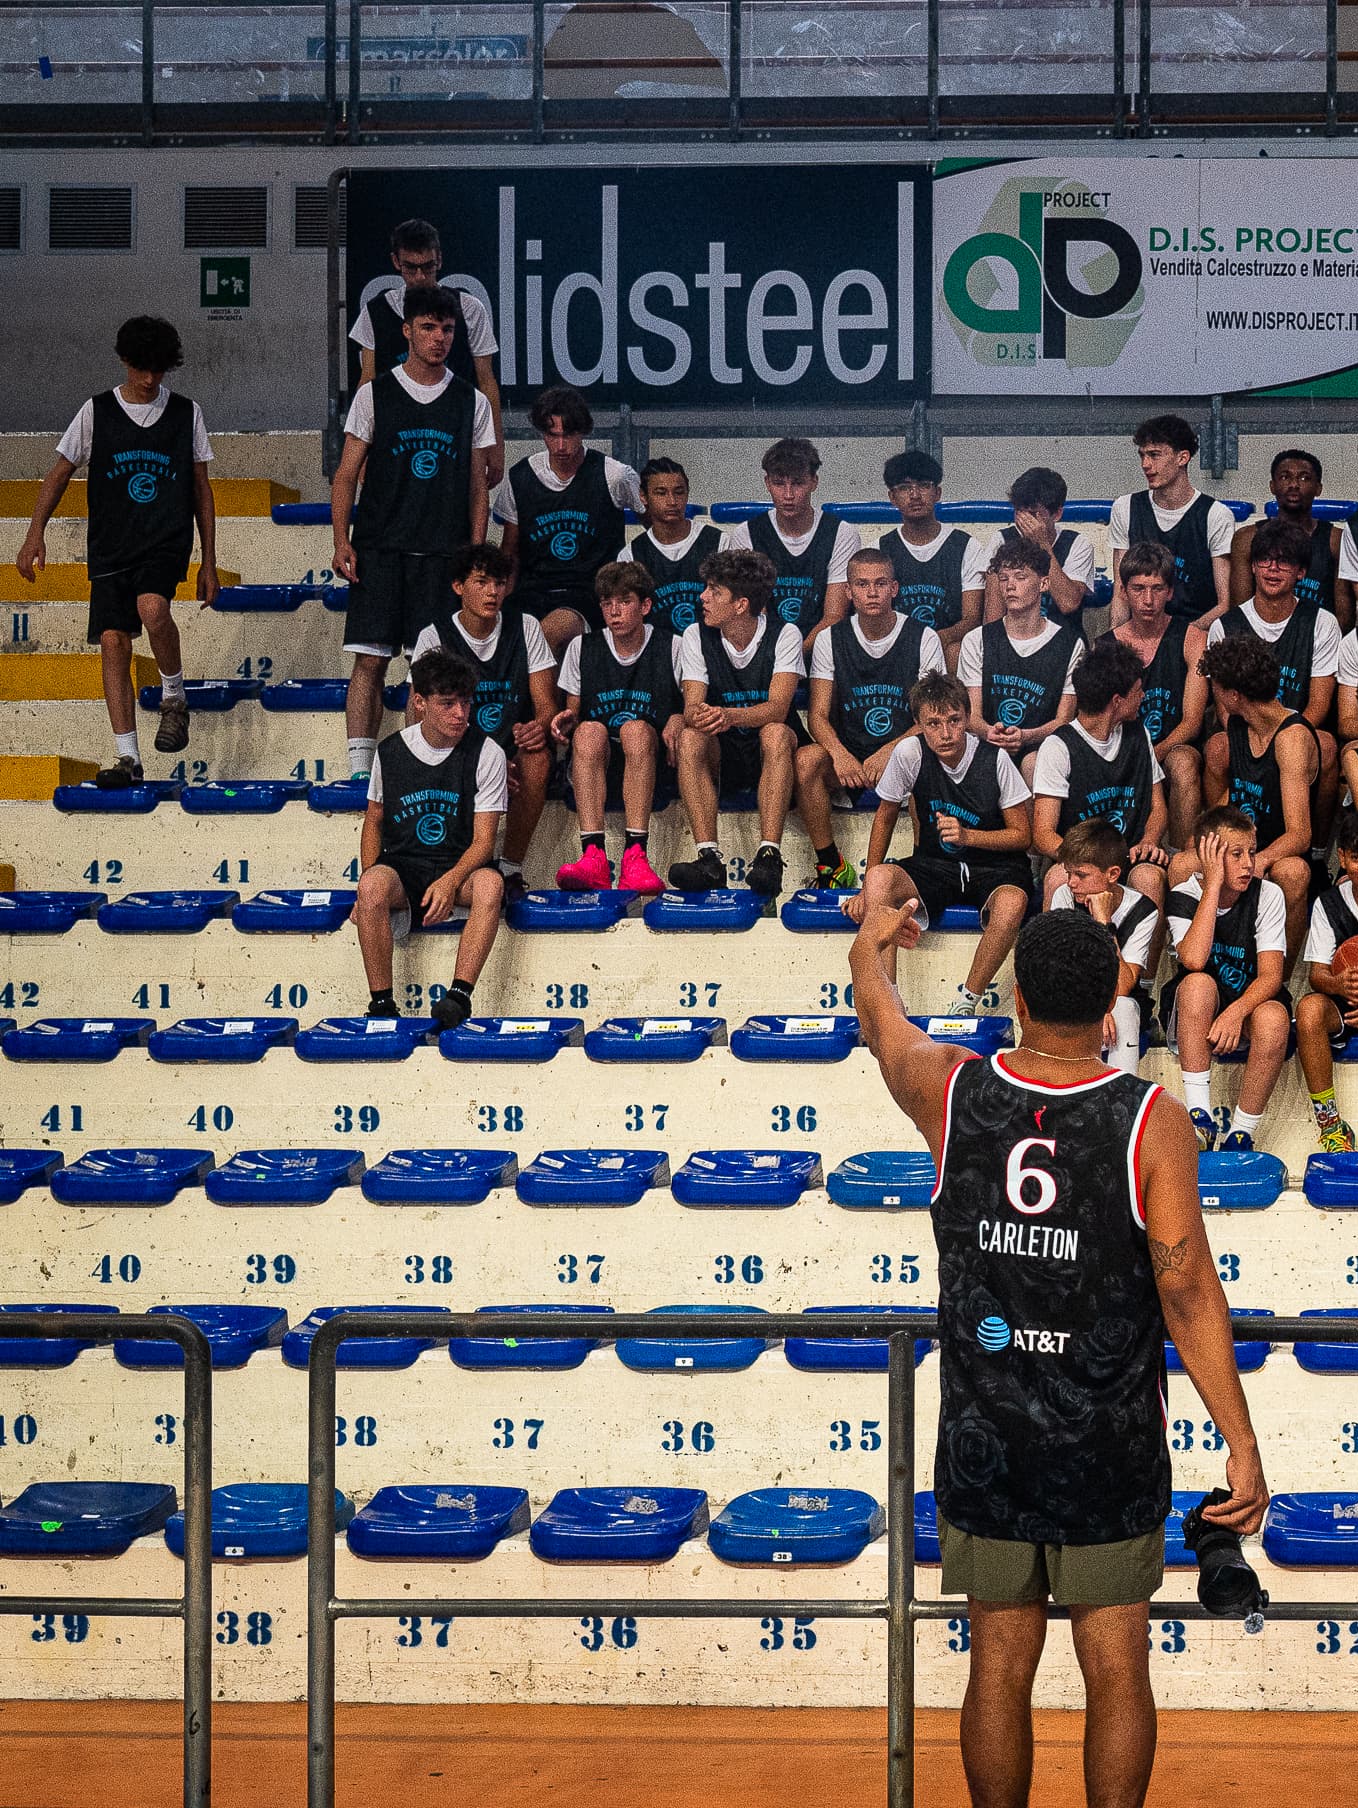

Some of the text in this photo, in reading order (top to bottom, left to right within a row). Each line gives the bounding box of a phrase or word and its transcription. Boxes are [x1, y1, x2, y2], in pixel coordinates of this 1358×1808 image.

[1043, 192, 1111, 208] PROJECT
[1149, 227, 1225, 253] D.I.S.
[1150, 258, 1203, 277] Vendita
[1206, 258, 1297, 278] Calcestruzzo
[1300, 264, 1309, 278] e
[997, 344, 1042, 360] D.I.S.
[237, 657, 273, 678] 42
[597, 690, 651, 703] TRANSFMING
[170, 761, 209, 781] 42
[290, 760, 325, 781] 41
[400, 789, 460, 806] TRANSFORMING
[83, 860, 123, 883] 42
[212, 860, 250, 882] 41
[342, 859, 358, 881] 4
[729, 857, 747, 881] 3
[0, 983, 40, 1008] 42
[132, 983, 171, 1008] 41
[265, 983, 308, 1008] 40
[547, 985, 588, 1008] 38
[680, 983, 719, 1007] 37
[820, 983, 855, 1008] 36
[41, 1106, 82, 1131] 41
[187, 1105, 234, 1131] 40
[335, 1106, 379, 1132] 39
[479, 1106, 523, 1131] 38
[626, 1105, 668, 1131] 37
[772, 1106, 816, 1132] 36
[1006, 1137, 1057, 1215] 6
[979, 1220, 1079, 1262] CARLETON
[92, 1254, 142, 1284] 40
[247, 1255, 295, 1283] 39
[405, 1256, 452, 1283] 38
[559, 1255, 604, 1283] 37
[715, 1256, 763, 1283] 36
[872, 1255, 919, 1283] 35
[1220, 1254, 1241, 1282] 3
[1013, 1330, 1071, 1354] AT&T
[155, 1414, 176, 1445] 3
[493, 1419, 544, 1449] 37
[662, 1422, 714, 1452] 36
[830, 1421, 881, 1450] 35
[1172, 1420, 1224, 1450] 33
[31, 1613, 90, 1642] 39
[216, 1611, 272, 1645] 38
[398, 1617, 453, 1647] 37
[581, 1617, 638, 1651] 36
[760, 1618, 816, 1651] 35
[948, 1619, 971, 1652] 3
